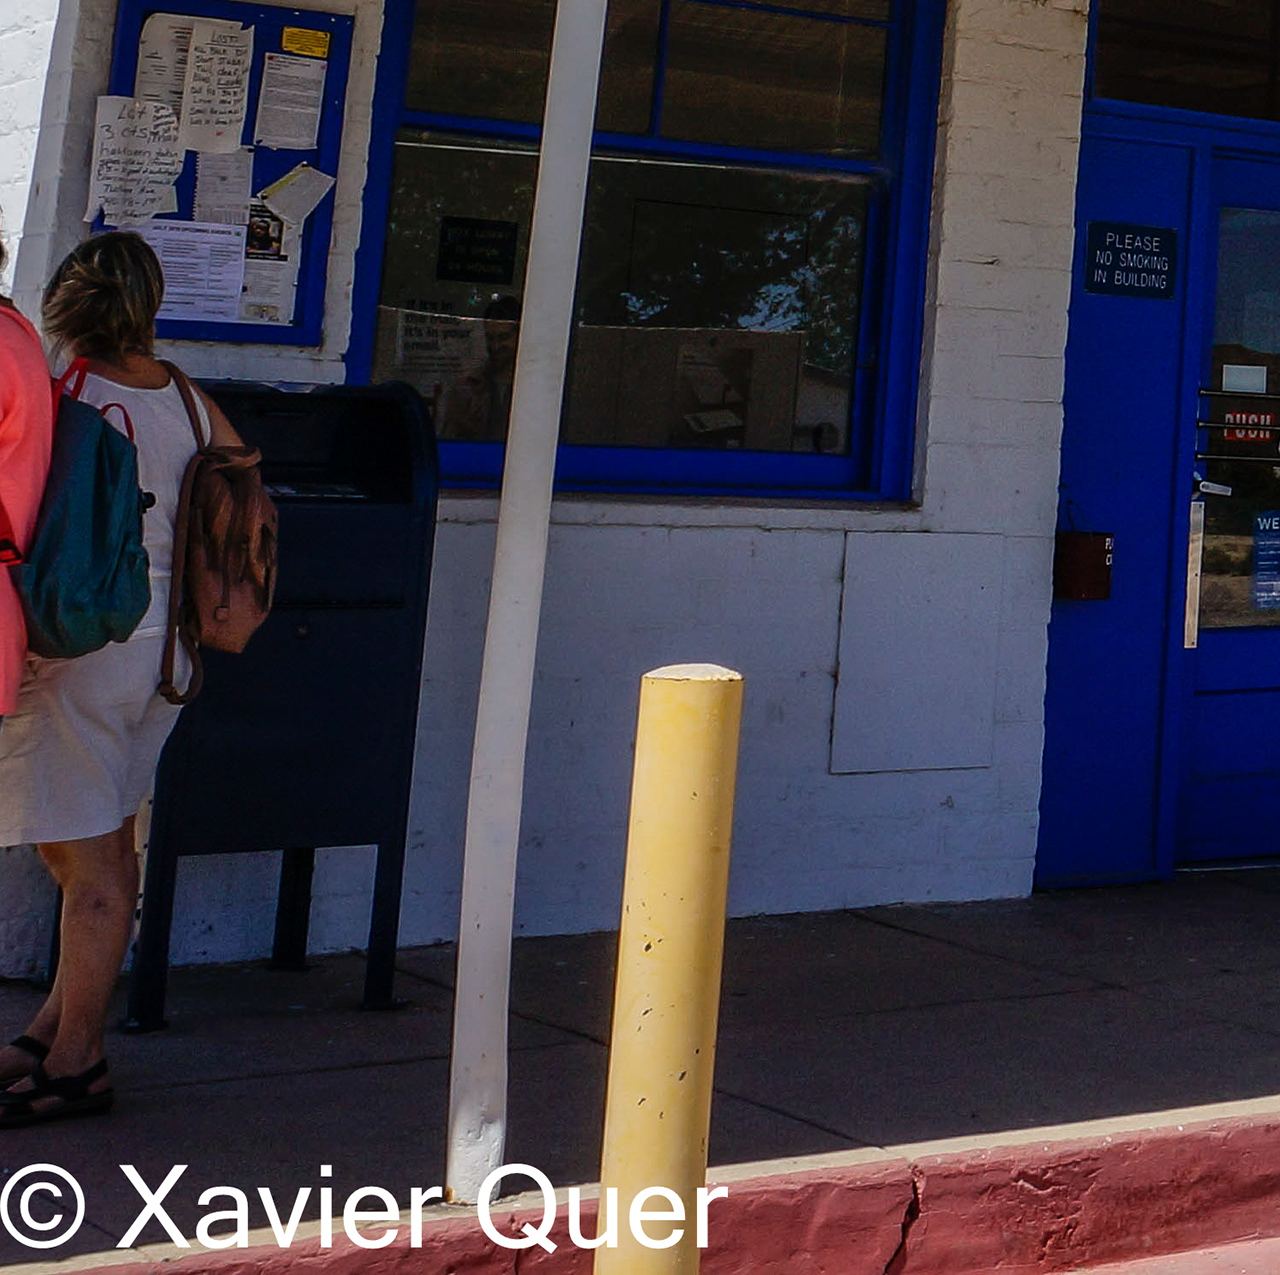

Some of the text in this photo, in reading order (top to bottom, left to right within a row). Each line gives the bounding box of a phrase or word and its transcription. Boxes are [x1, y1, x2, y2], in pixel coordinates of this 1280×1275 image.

[1105, 232, 1161, 252] PLEASE
[1096, 250, 1168, 272] NO SMOKING
[1094, 269, 1167, 289] IN BUILDING
[1224, 412, 1273, 439] PUSH
